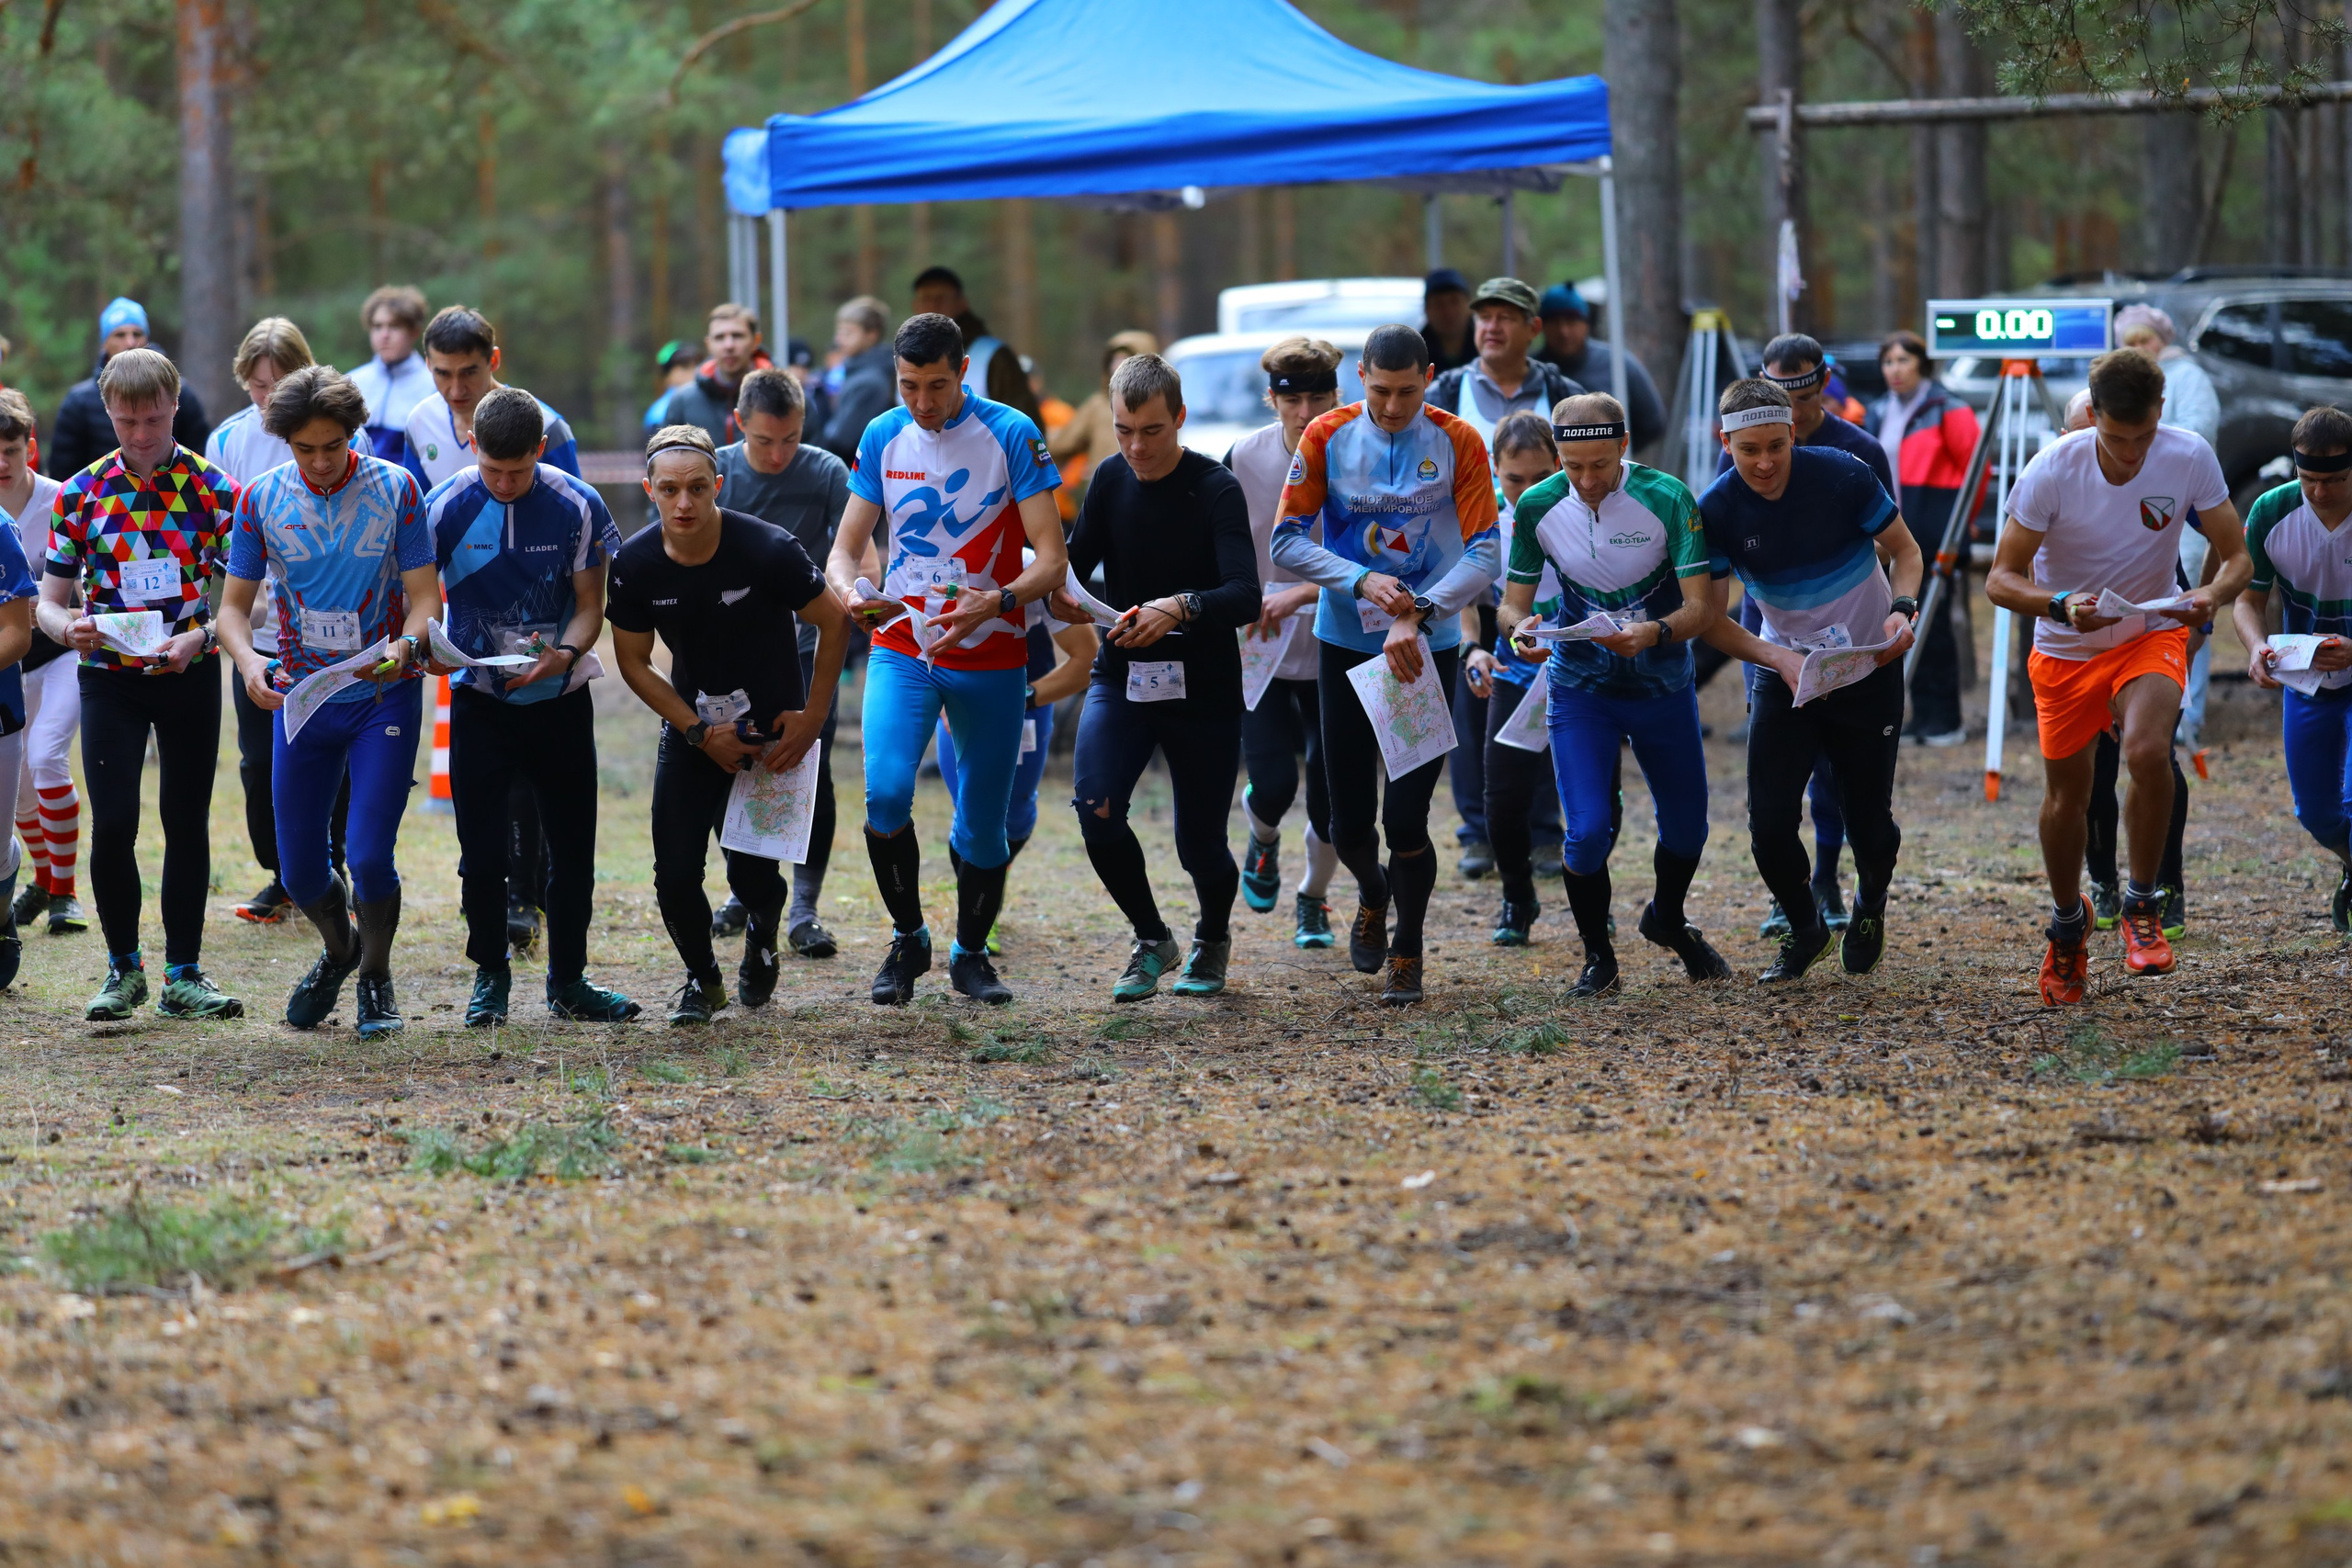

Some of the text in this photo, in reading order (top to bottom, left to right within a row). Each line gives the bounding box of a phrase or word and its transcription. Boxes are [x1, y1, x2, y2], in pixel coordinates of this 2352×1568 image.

[1975, 309, 2053, 340] 0.00
[1779, 373, 1817, 389] oname
[1741, 409, 1789, 423] noname
[1563, 427, 1613, 437] noname
[886, 469, 926, 480] REDLINE
[1350, 494, 1433, 505] СПОРТИВНОЕ
[1343, 502, 1441, 514] РИЕНТИРОВАНИЕ
[1609, 536, 1652, 545] EKB-O-TEAM
[525, 544, 559, 553] LEADER
[933, 570, 942, 583] 6
[143, 576, 161, 591] 12
[322, 625, 336, 637] 11
[1150, 676, 1159, 689] 5
[715, 706, 723, 716] 7
